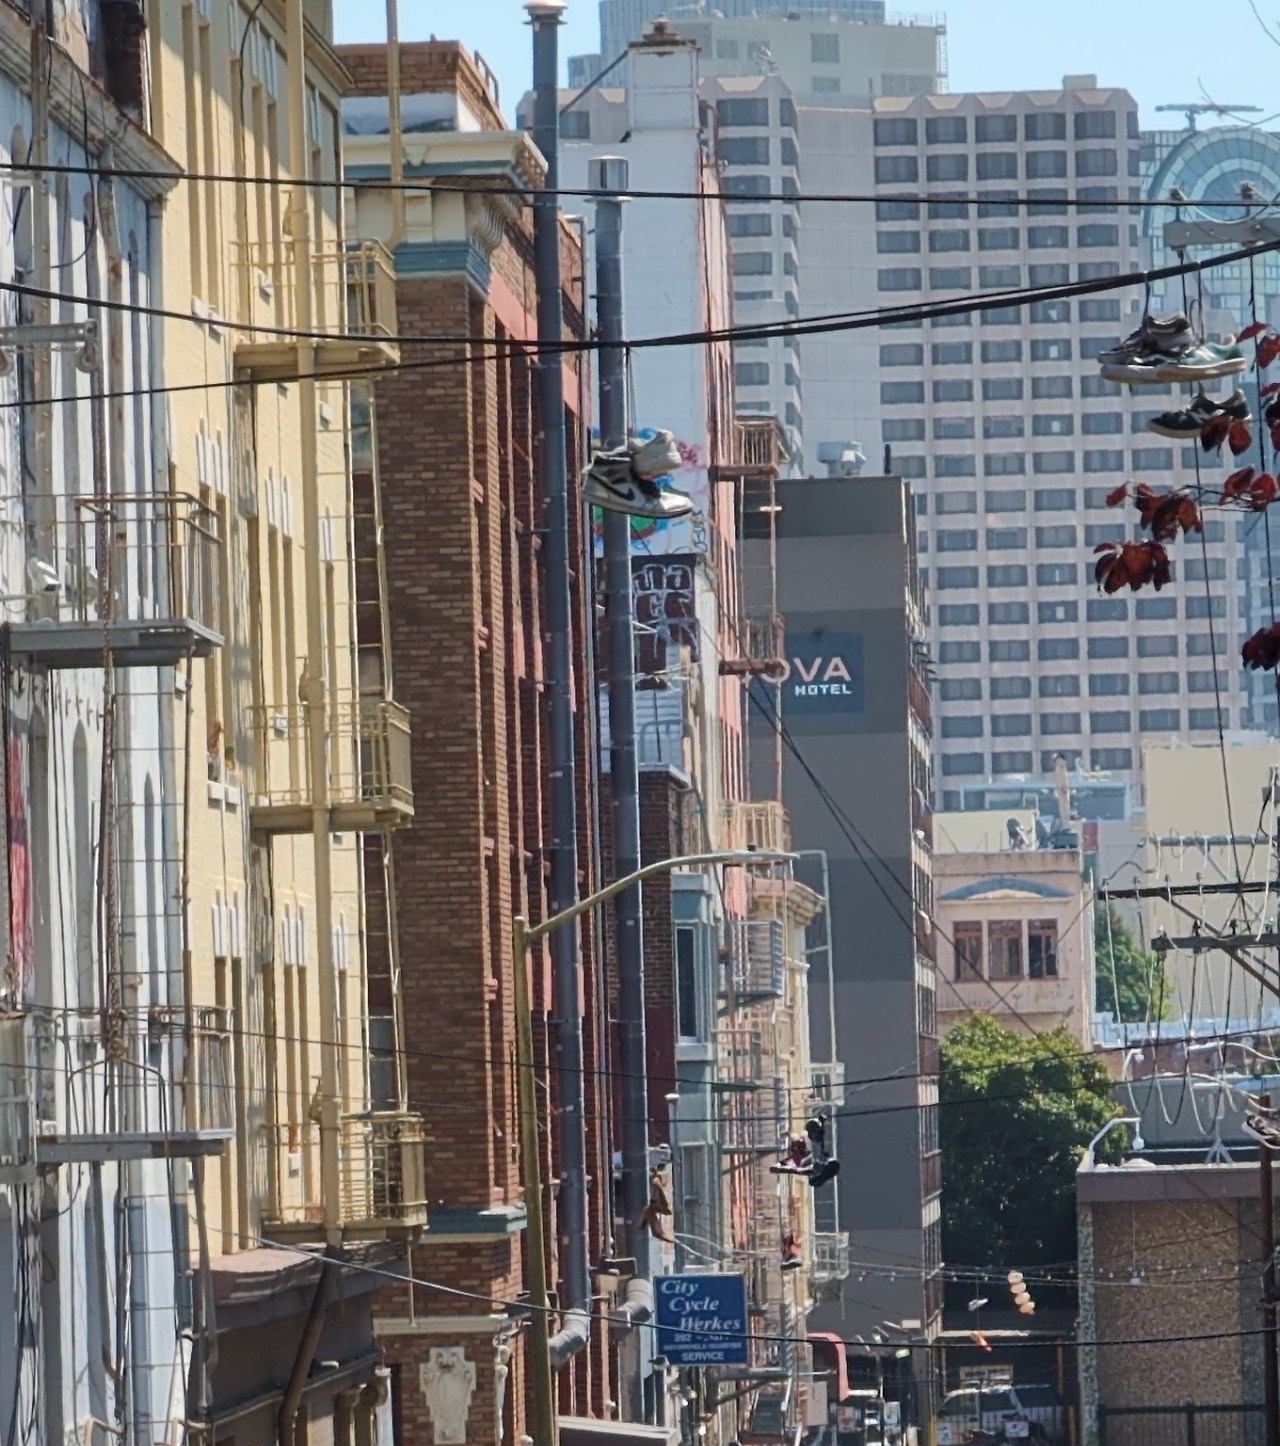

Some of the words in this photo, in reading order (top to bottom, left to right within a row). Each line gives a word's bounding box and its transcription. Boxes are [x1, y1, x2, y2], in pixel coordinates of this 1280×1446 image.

[747, 656, 852, 684] OVA
[795, 684, 853, 696] HOTEL
[661, 1279, 699, 1297] City
[669, 1296, 720, 1315] Cycle
[679, 1316, 741, 1332] Werkes
[681, 1351, 725, 1361] SERVICE
